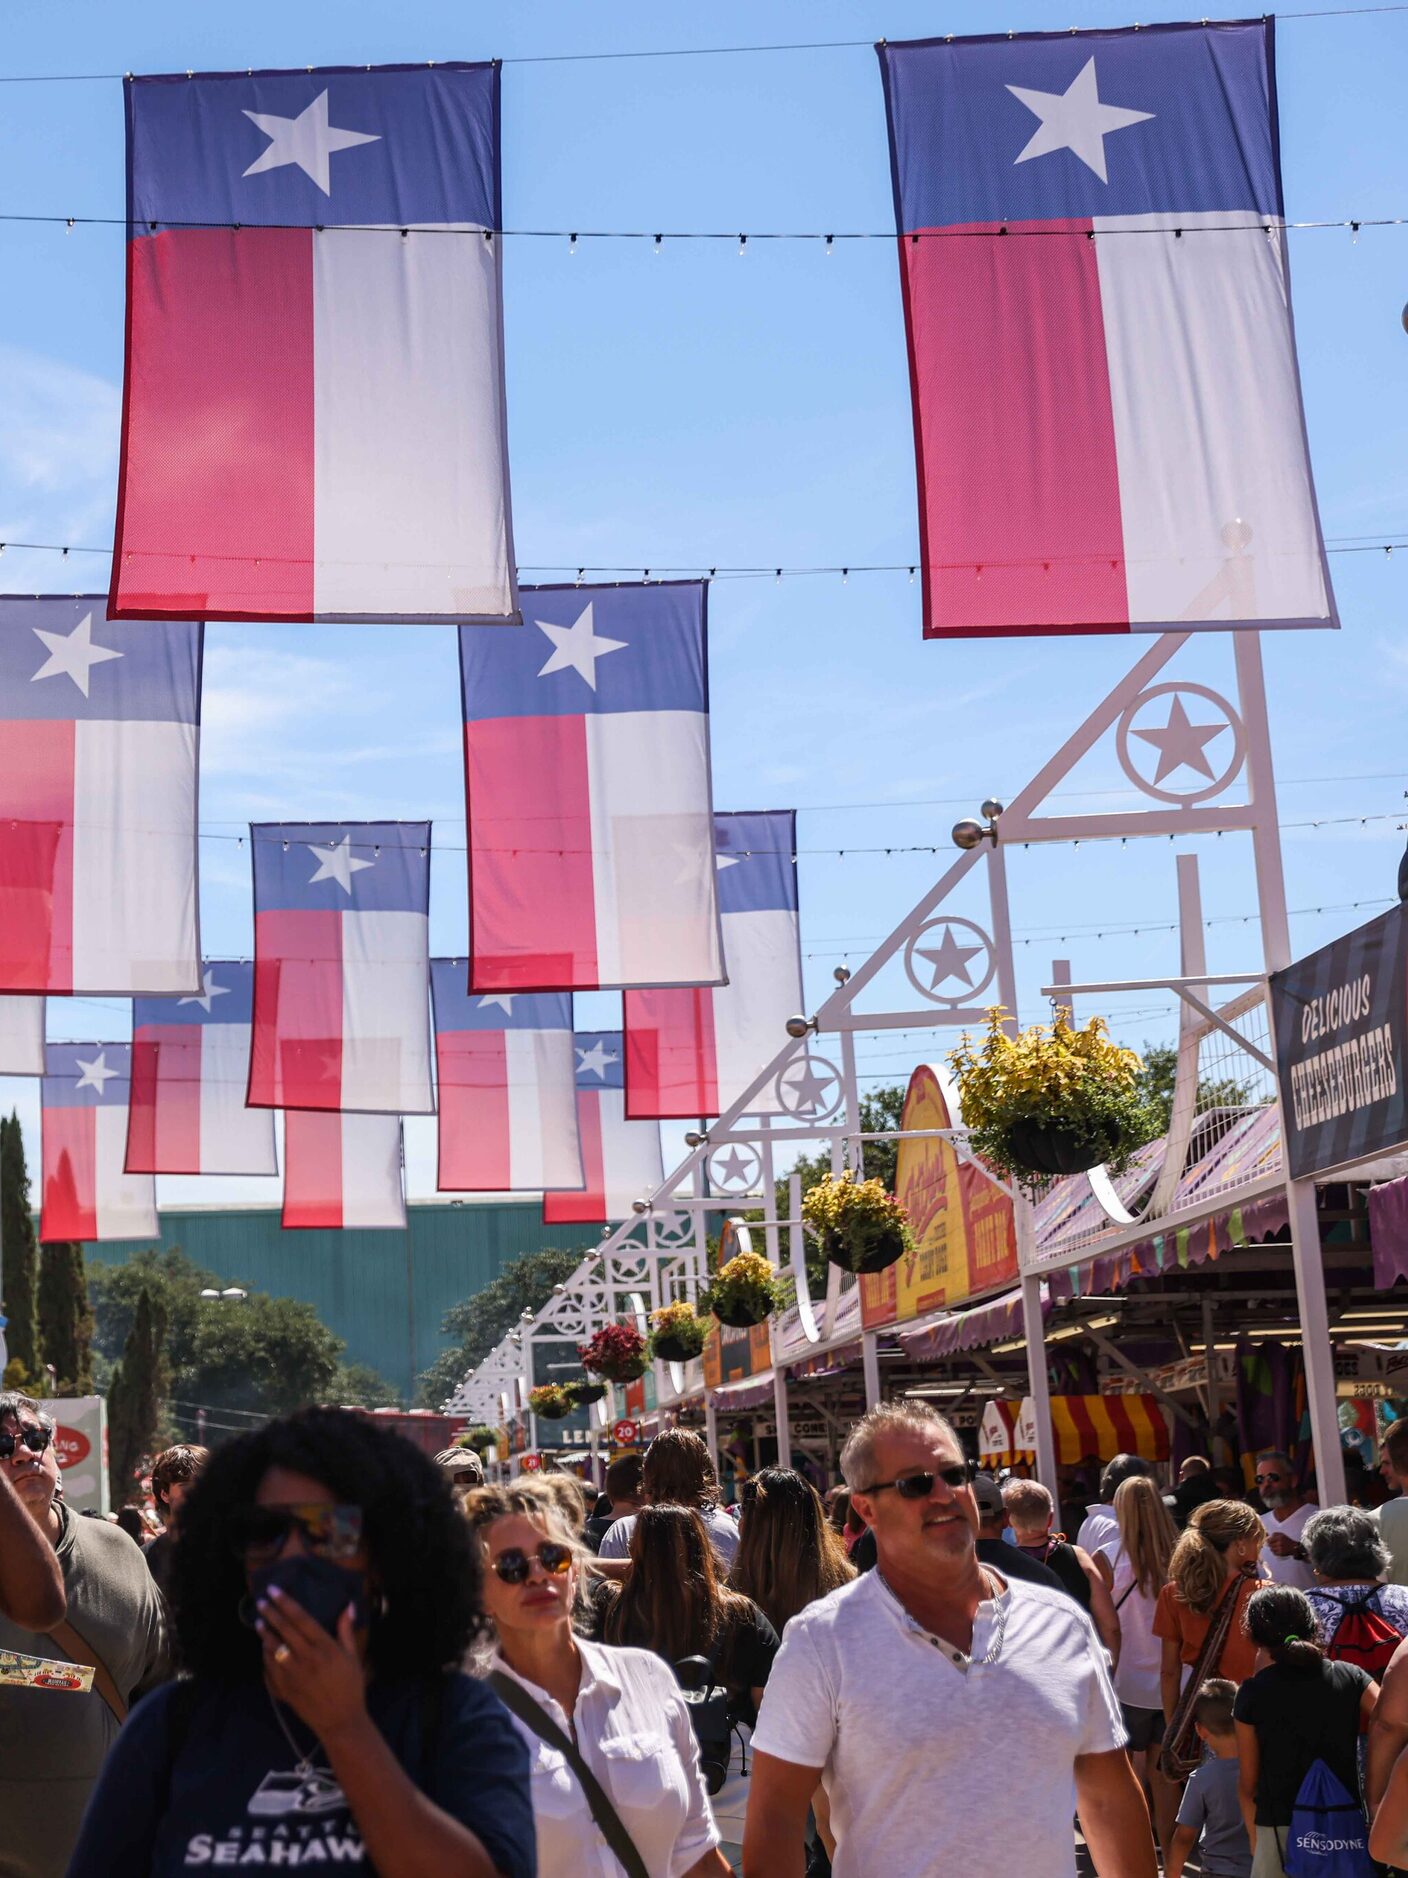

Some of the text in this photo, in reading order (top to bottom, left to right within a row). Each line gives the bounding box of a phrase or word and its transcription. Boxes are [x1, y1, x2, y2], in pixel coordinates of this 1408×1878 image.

[1301, 973, 1370, 1044] DELICIOUS
[1290, 1022, 1397, 1132] CHEESEBURGERS
[617, 1426, 634, 1438] 20
[228, 1818, 358, 1840] SEATTL
[183, 1832, 365, 1866] SEAHAW
[1296, 1836, 1364, 1851] SENSODYNE
